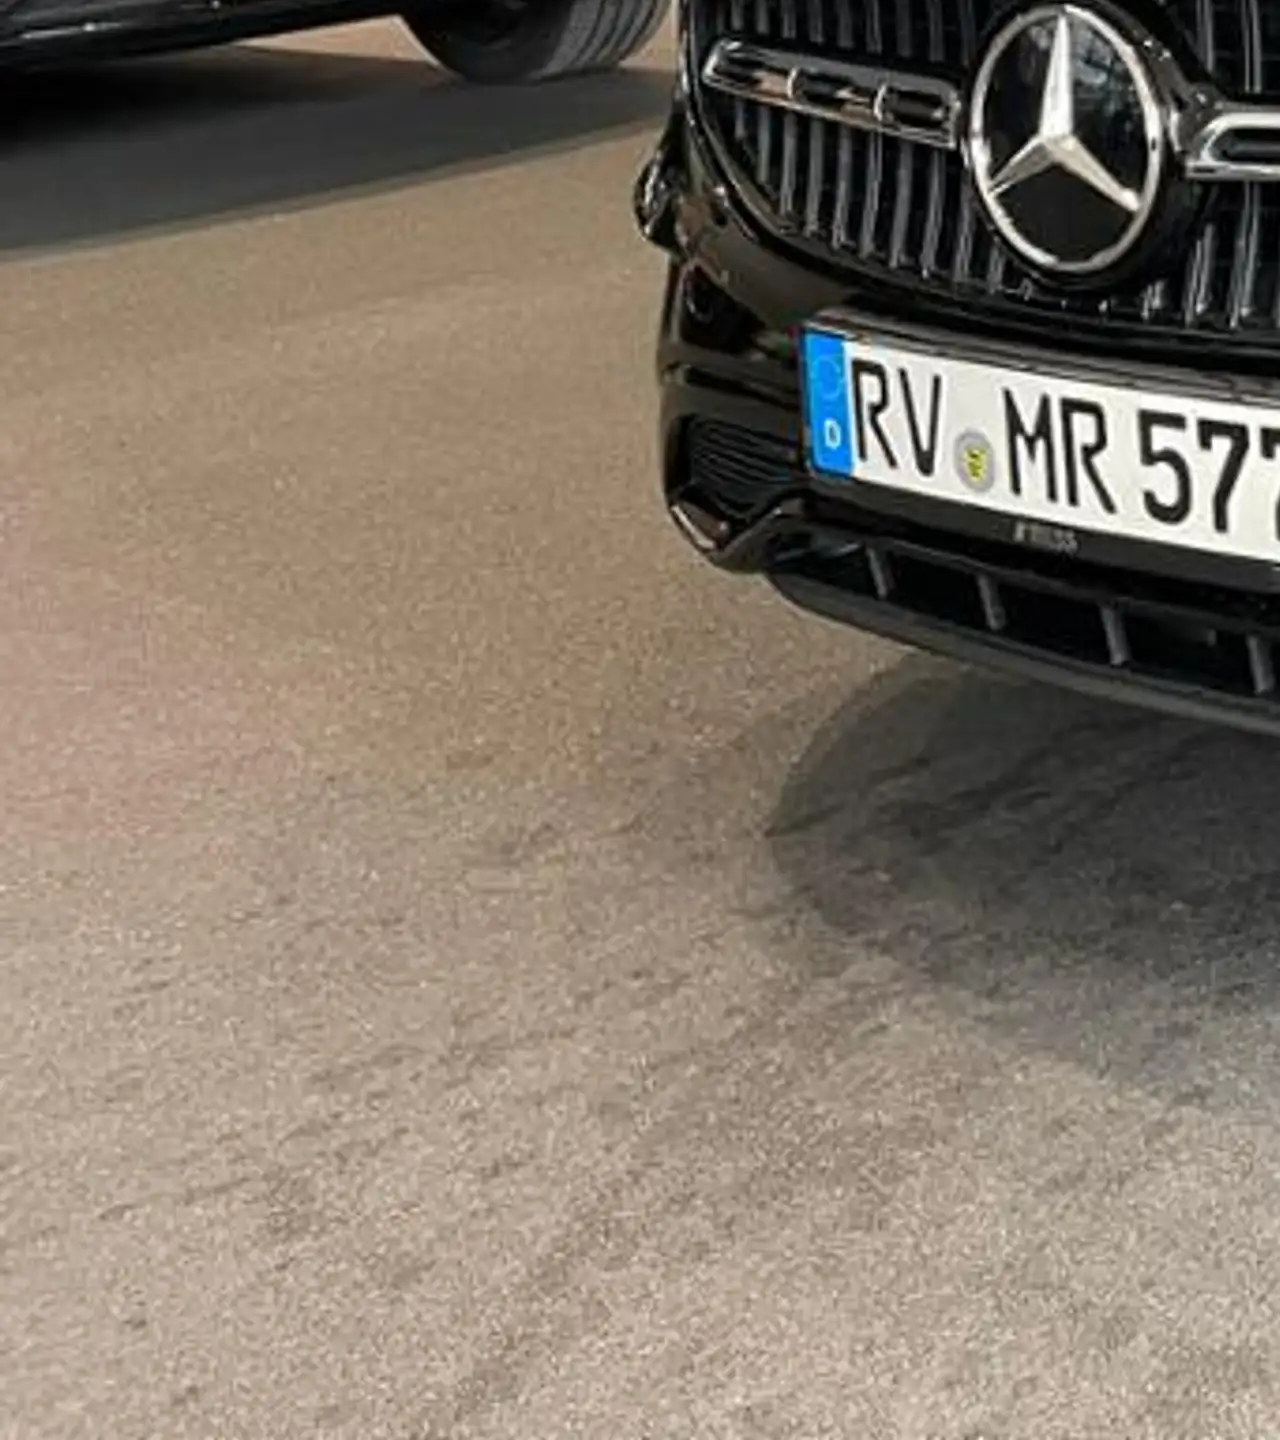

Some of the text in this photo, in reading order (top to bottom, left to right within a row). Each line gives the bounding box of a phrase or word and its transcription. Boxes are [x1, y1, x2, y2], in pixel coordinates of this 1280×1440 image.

[823, 417, 842, 449] D
[852, 358, 942, 477] RV
[1003, 387, 1118, 515] MR
